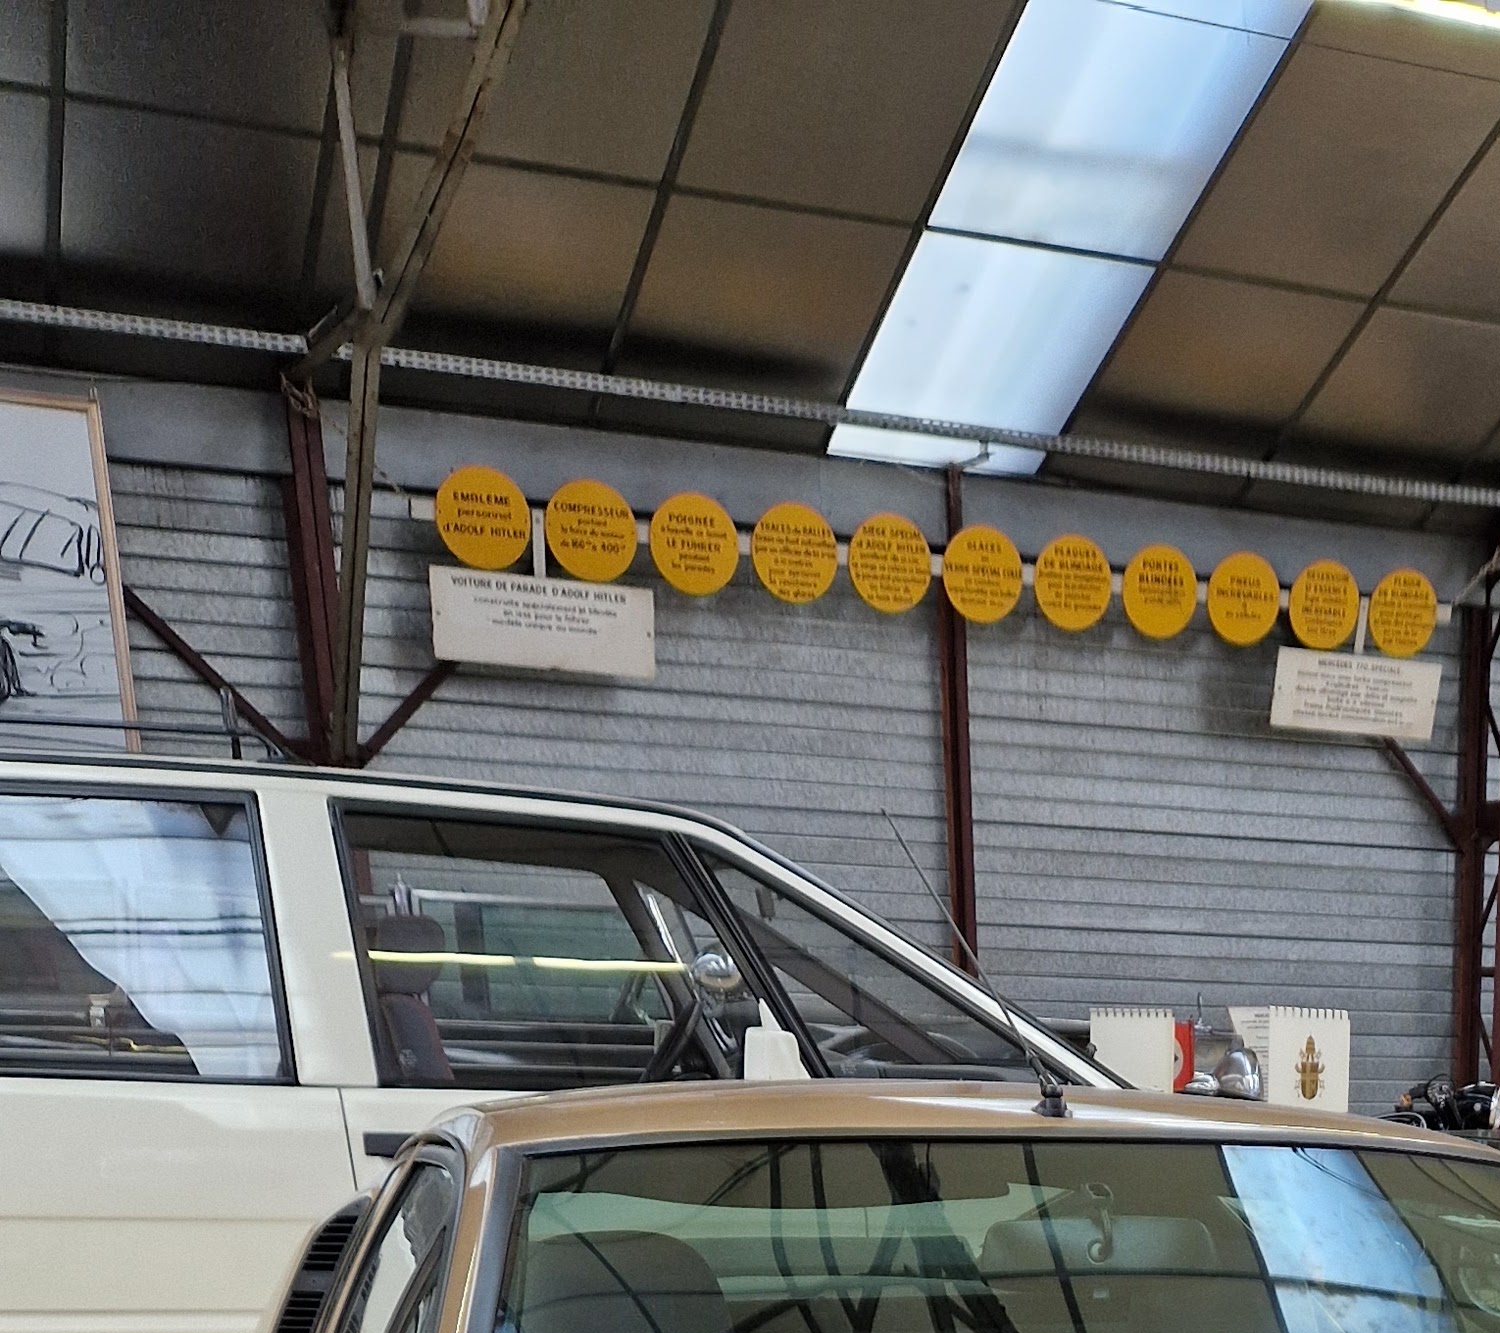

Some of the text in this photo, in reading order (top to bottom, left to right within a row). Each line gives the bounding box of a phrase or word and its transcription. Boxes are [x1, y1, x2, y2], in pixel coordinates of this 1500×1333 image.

[553, 502, 629, 520] COMPRESSEUR
[490, 525, 527, 541] HITLER
[451, 576, 493, 591] VOITURE
[495, 580, 508, 593] DE
[510, 581, 549, 597] PARADE
[593, 591, 628, 605] HITLER
